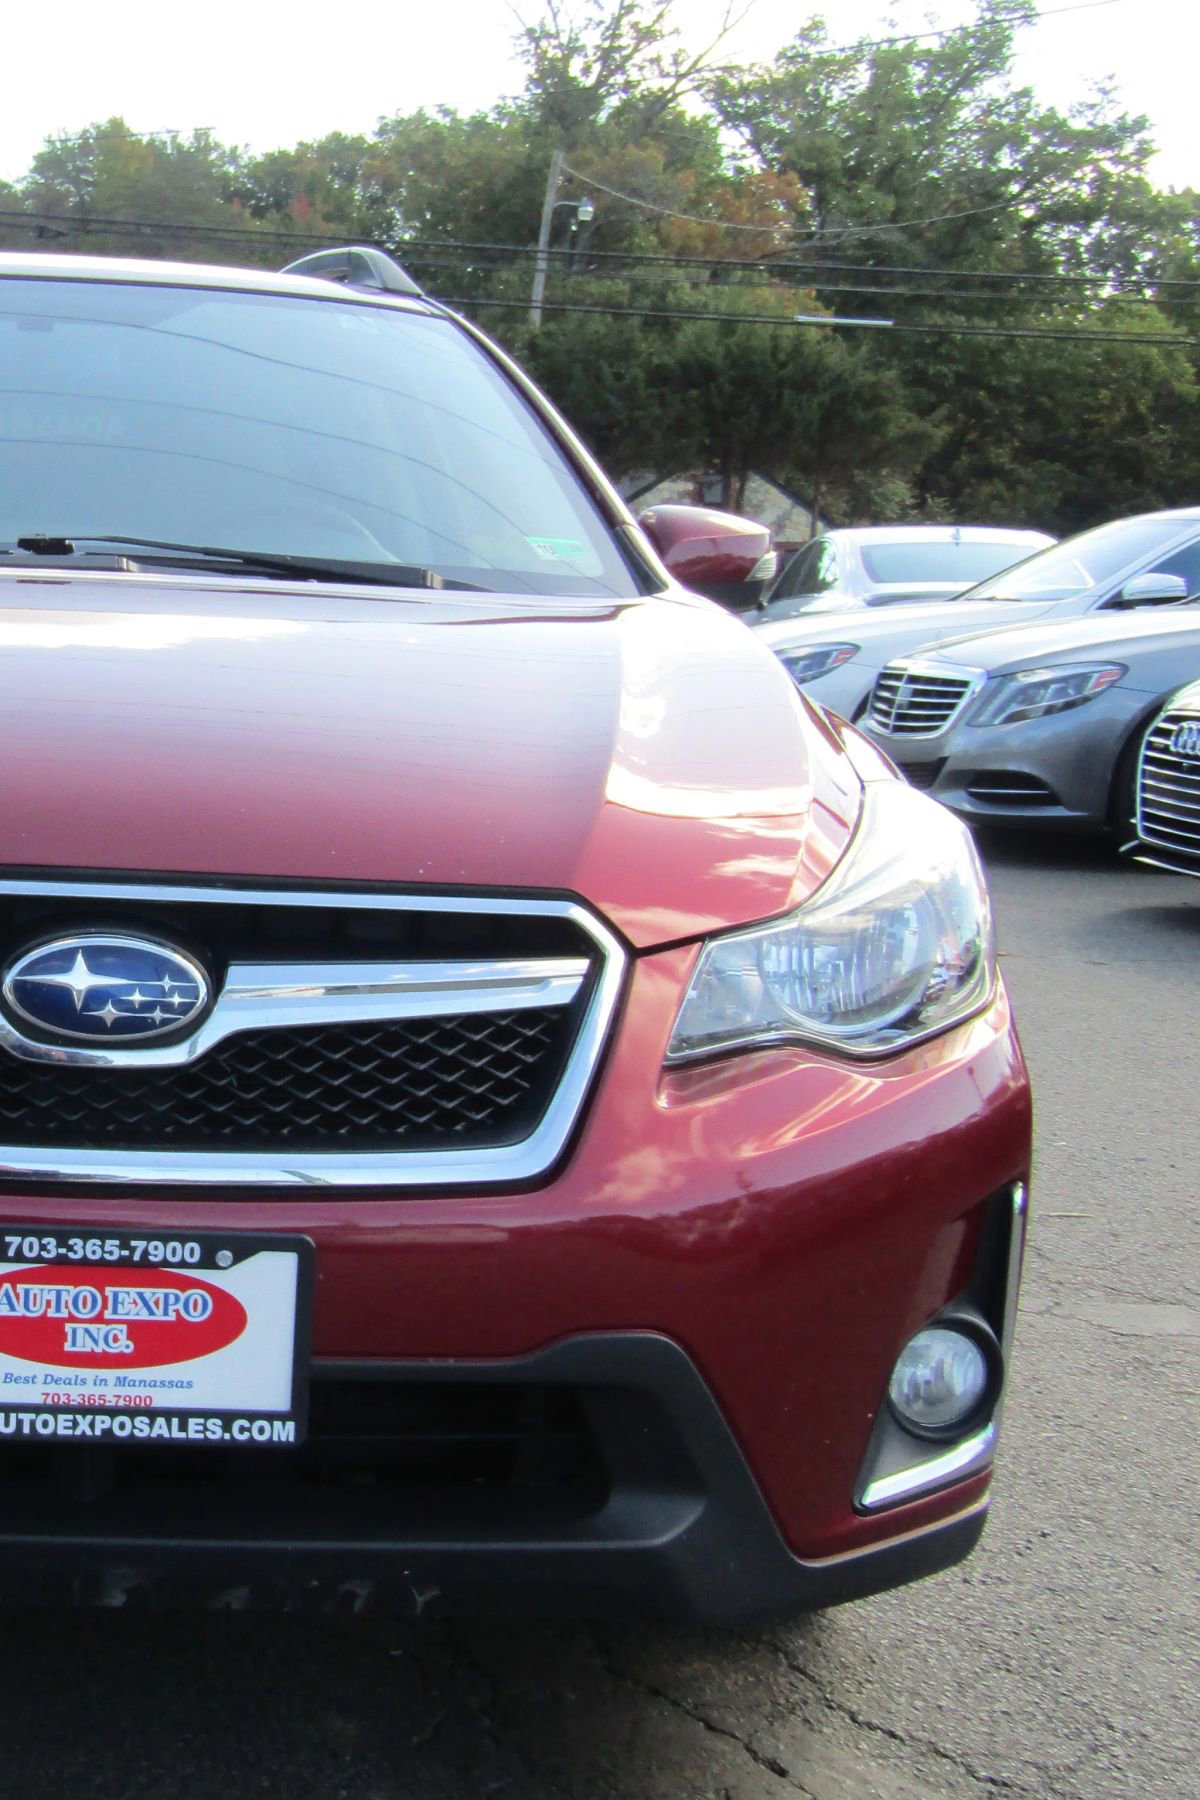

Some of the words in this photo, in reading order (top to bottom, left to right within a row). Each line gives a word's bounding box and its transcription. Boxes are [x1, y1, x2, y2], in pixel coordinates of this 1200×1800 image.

[5, 1236, 201, 1263] 703-365-7900
[104, 1286, 213, 1322] EXPO
[64, 1323, 134, 1354] INC.
[1, 1371, 38, 1385] Best
[43, 1372, 88, 1388] Deals
[92, 1374, 109, 1388] in
[114, 1375, 195, 1390] Manassas
[41, 1392, 153, 1407] 703-365-7900
